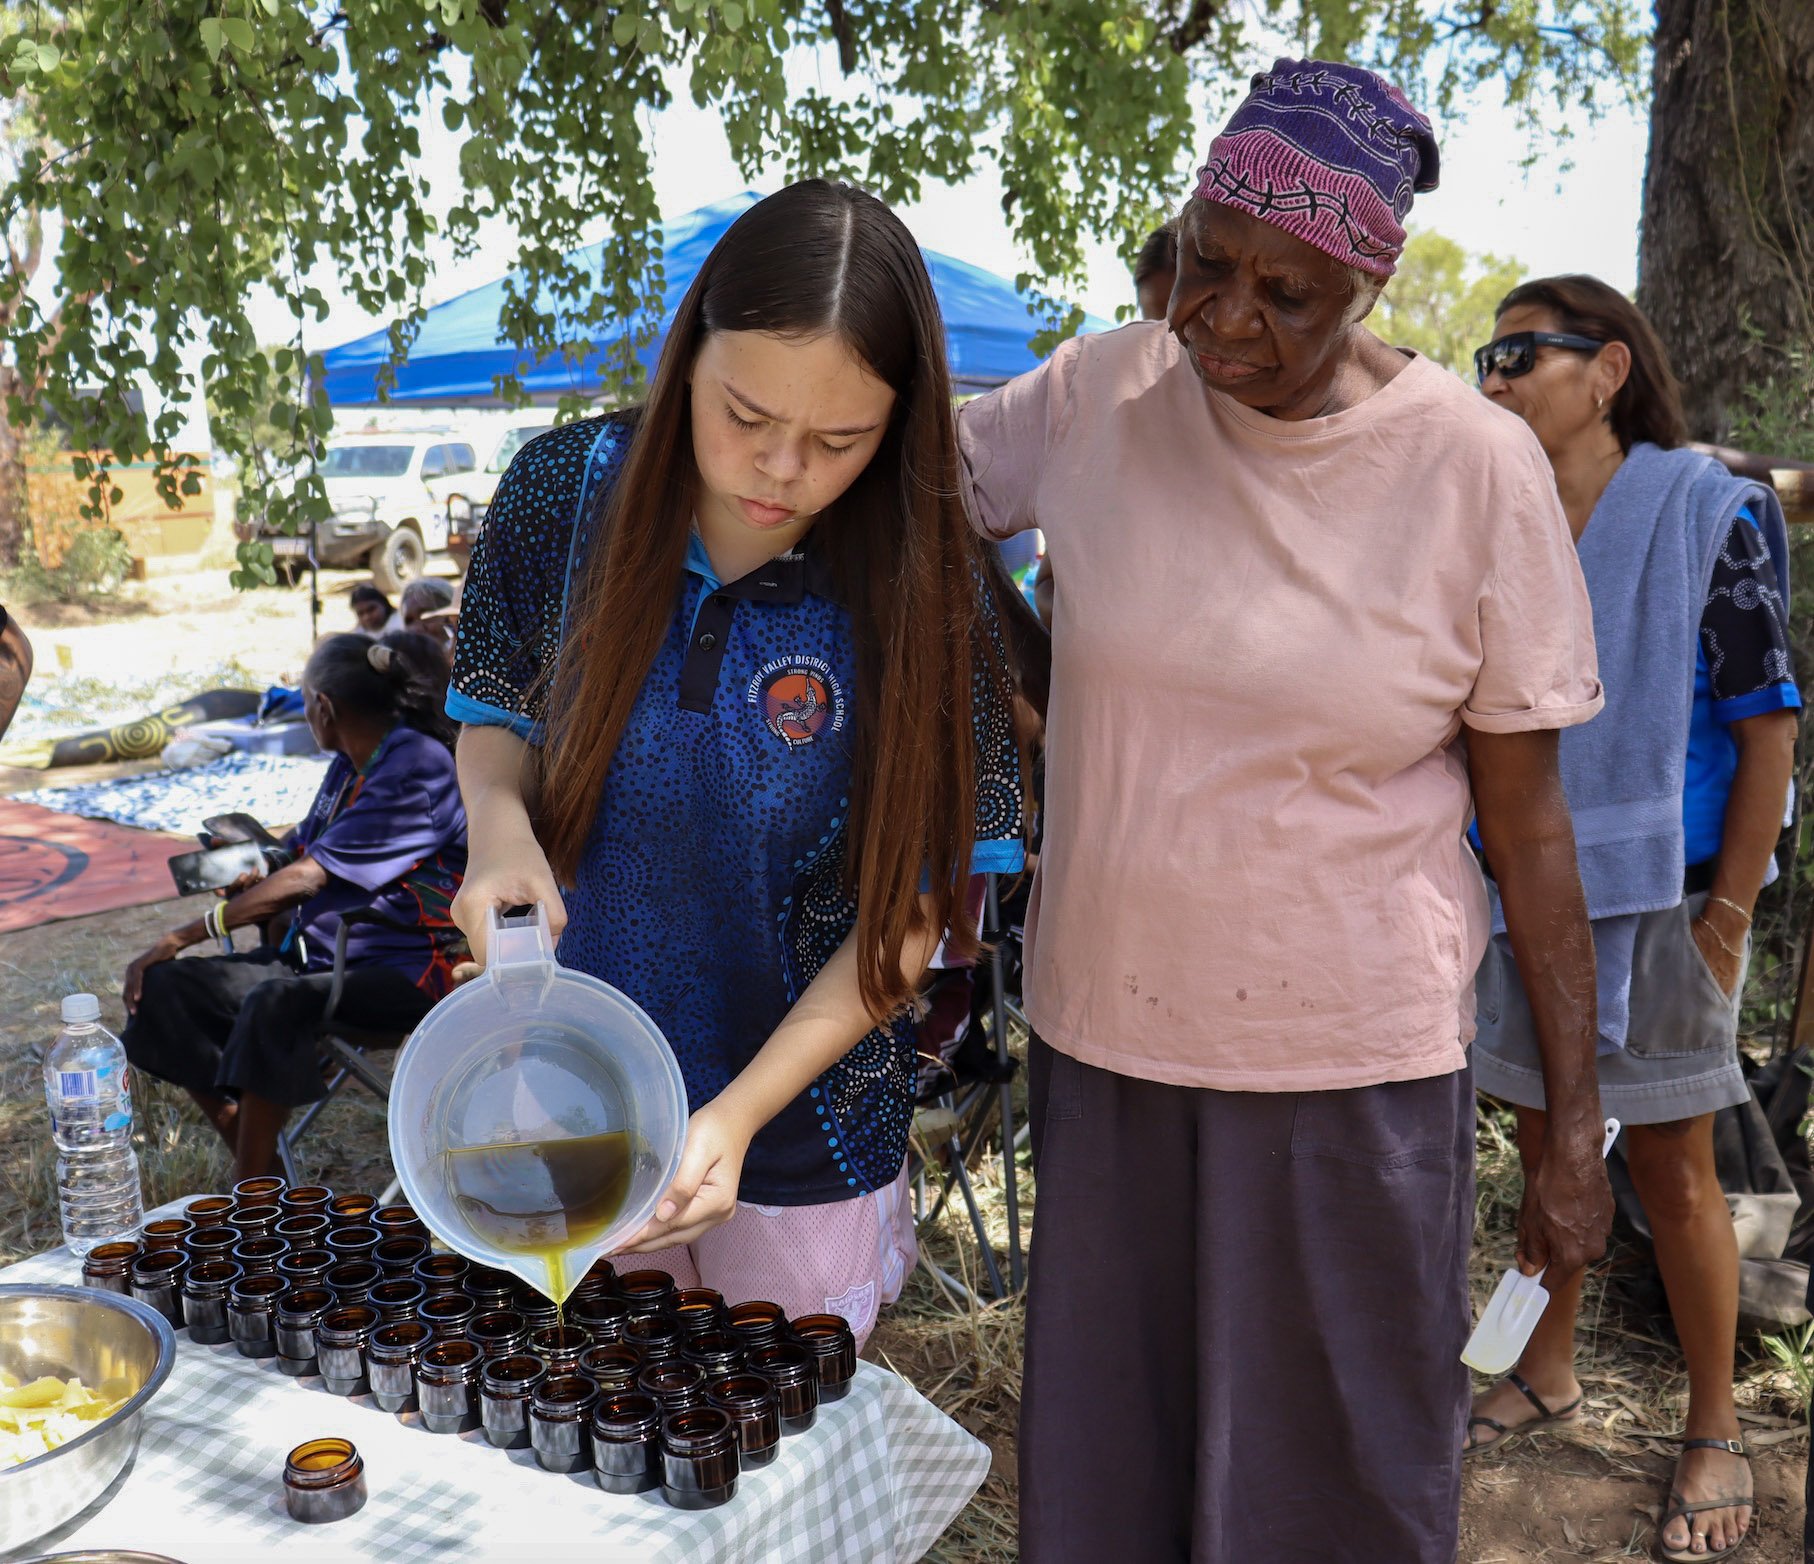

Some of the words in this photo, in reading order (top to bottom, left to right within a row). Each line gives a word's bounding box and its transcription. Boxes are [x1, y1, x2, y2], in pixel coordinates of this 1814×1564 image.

[762, 655, 792, 675] VALLEY
[795, 654, 831, 674] DISTRICT
[748, 670, 766, 703] FITZROY
[828, 672, 842, 696] HIGH
[831, 698, 845, 732] SCHOOL
[792, 736, 814, 746] CULTURE
